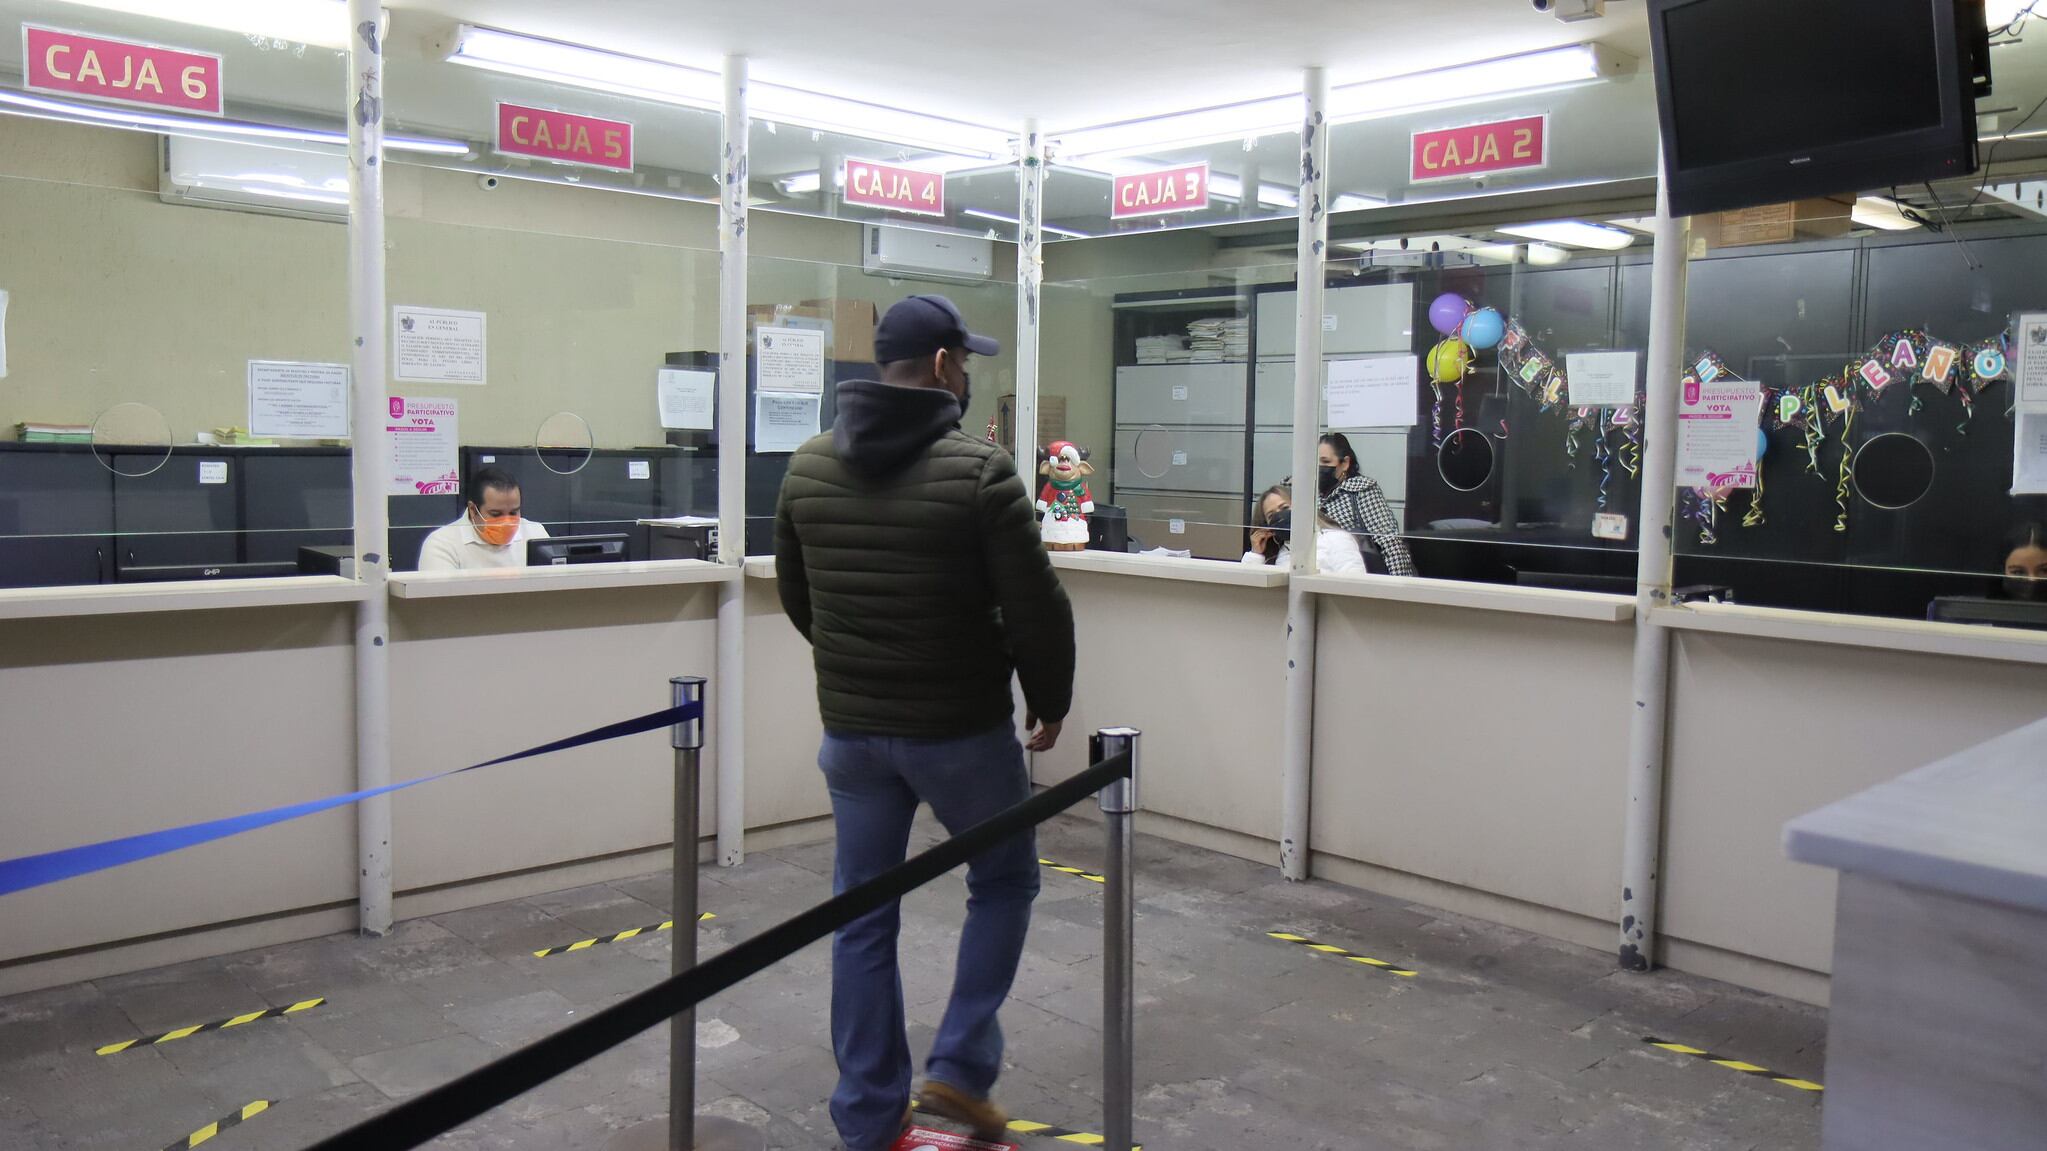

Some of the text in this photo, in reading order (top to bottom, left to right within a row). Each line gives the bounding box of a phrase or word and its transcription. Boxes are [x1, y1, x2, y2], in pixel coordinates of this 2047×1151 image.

[45, 44, 208, 100] CAJA 6
[511, 116, 623, 159] CAJA 5
[1422, 129, 1532, 170] CAJA 2
[853, 167, 936, 205] CAJA 4
[1121, 172, 1200, 207] CAJA 3
[407, 402, 455, 410] PRESUPUESTO
[1706, 404, 1732, 412] VOTA
